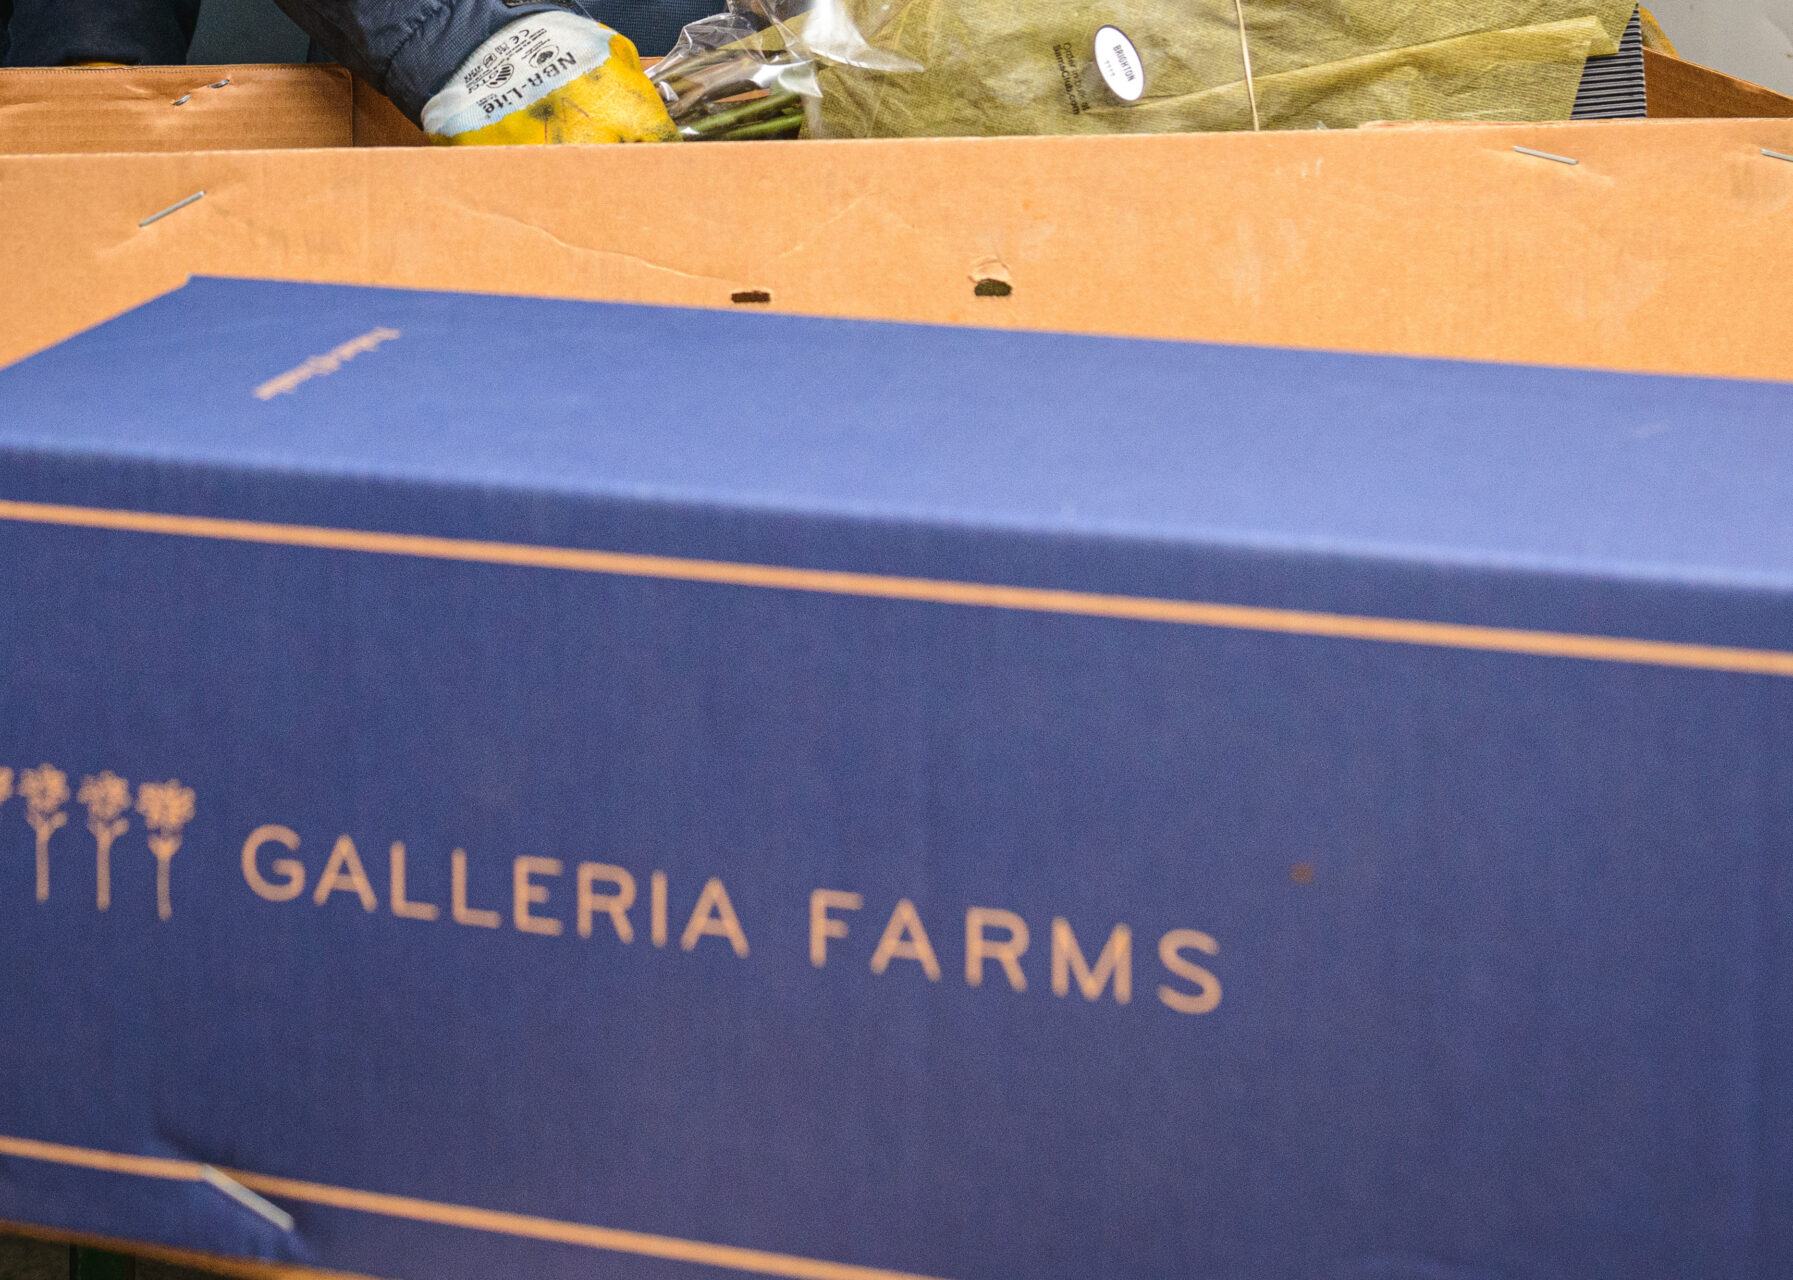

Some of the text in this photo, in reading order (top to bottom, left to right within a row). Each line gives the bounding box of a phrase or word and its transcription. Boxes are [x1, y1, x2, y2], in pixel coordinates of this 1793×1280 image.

[1113, 45, 1135, 82] BRIGHTON
[240, 822, 1223, 1016] GALLERIA FARMS
